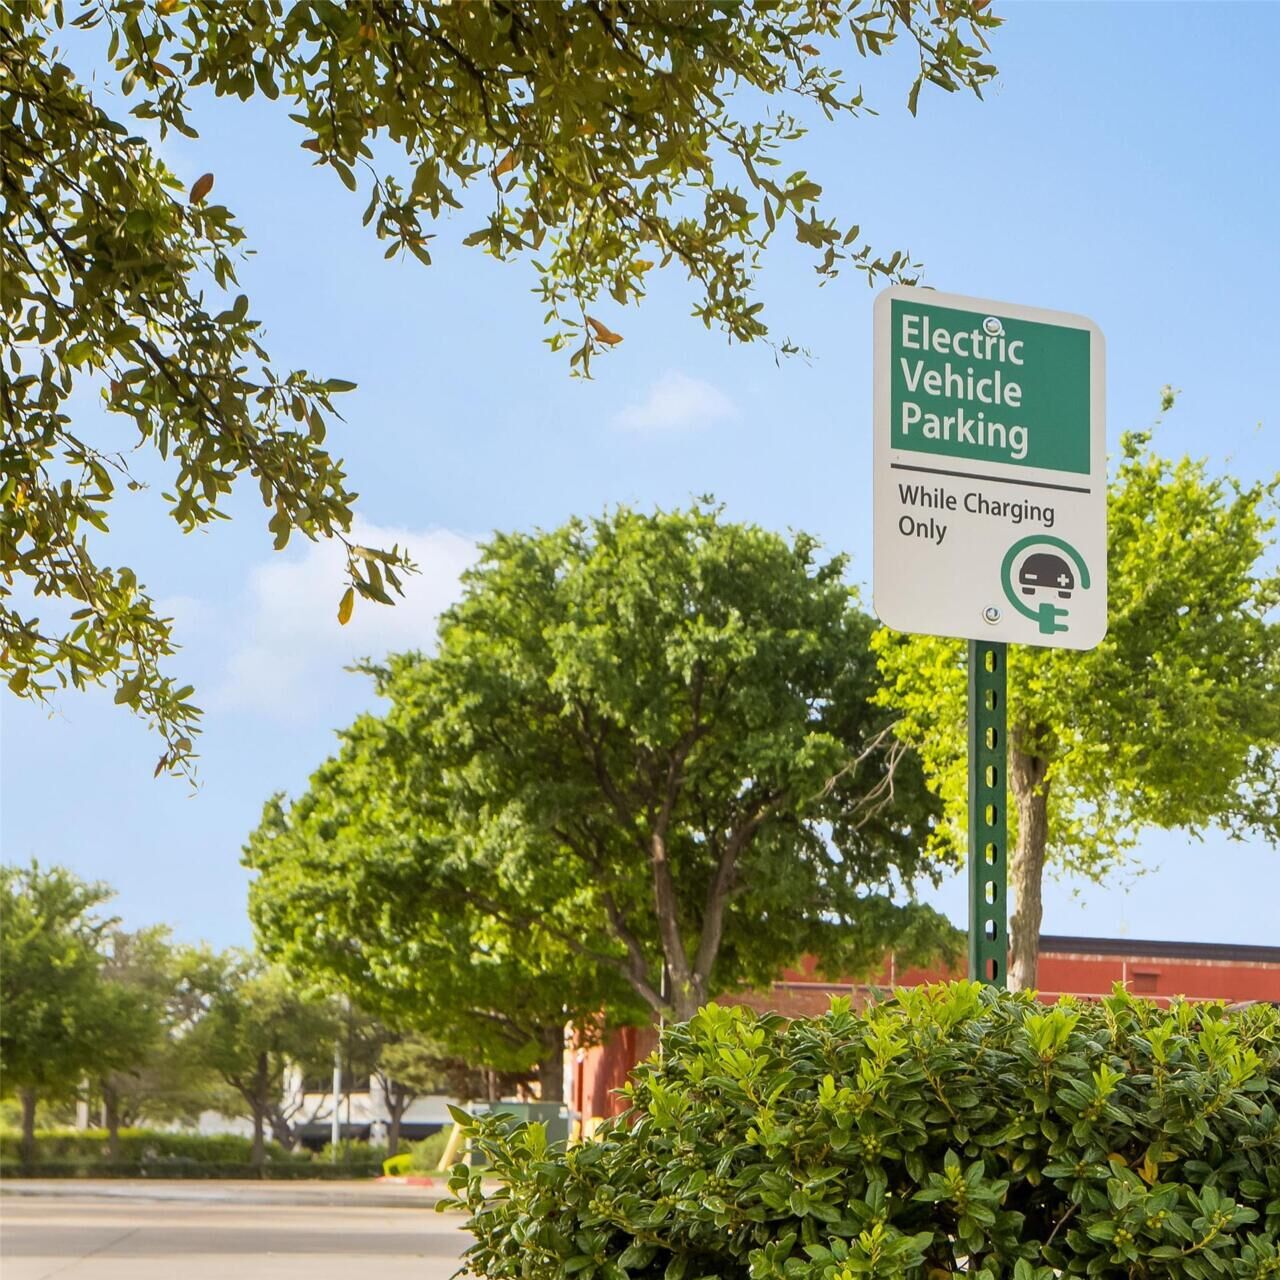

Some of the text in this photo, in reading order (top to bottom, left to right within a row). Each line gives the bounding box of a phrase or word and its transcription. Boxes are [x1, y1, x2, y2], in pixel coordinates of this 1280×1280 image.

[902, 315, 1024, 366] Electric
[900, 357, 1023, 408] Vehicle
[902, 401, 1029, 460] Parking
[898, 484, 1056, 528] While Charging
[898, 515, 947, 545] Only
